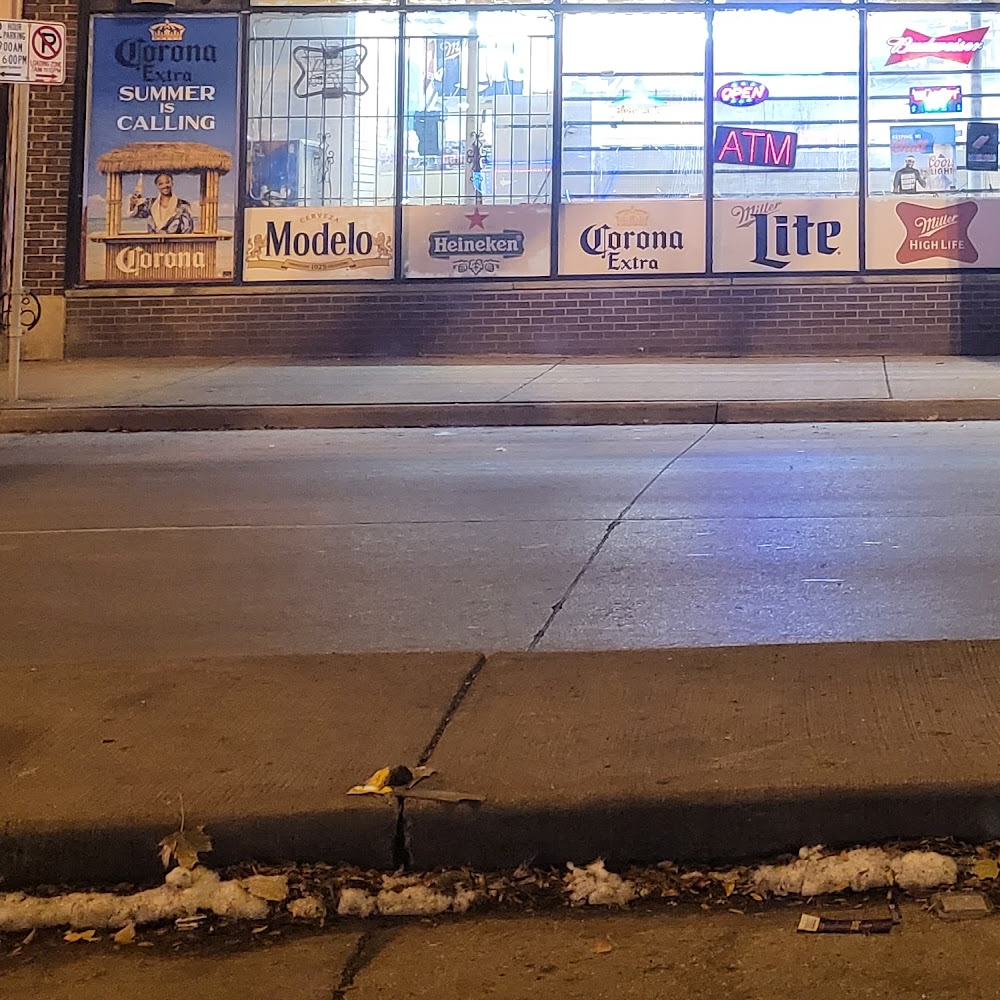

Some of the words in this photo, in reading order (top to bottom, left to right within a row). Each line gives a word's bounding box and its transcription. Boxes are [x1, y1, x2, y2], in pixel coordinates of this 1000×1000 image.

[4, 31, 26, 40] PARKING
[114, 38, 217, 70] Corona
[142, 65, 192, 82] Extra
[119, 86, 216, 101] SUMMER
[721, 85, 766, 102] OPEN
[159, 103, 175, 114] IS
[116, 115, 215, 131] CALLING
[718, 130, 792, 166] ATM
[300, 213, 340, 223] CERVEZA
[731, 202, 782, 229] Miller
[914, 214, 960, 238] Miller
[265, 221, 373, 256] Modelo
[434, 237, 520, 252] Heineken
[580, 223, 684, 258] Corona
[750, 214, 841, 269] Lite
[909, 239, 938, 250] HIGH
[941, 239, 965, 250] LIFE
[115, 246, 206, 276] Corona
[607, 252, 659, 270] Extra
